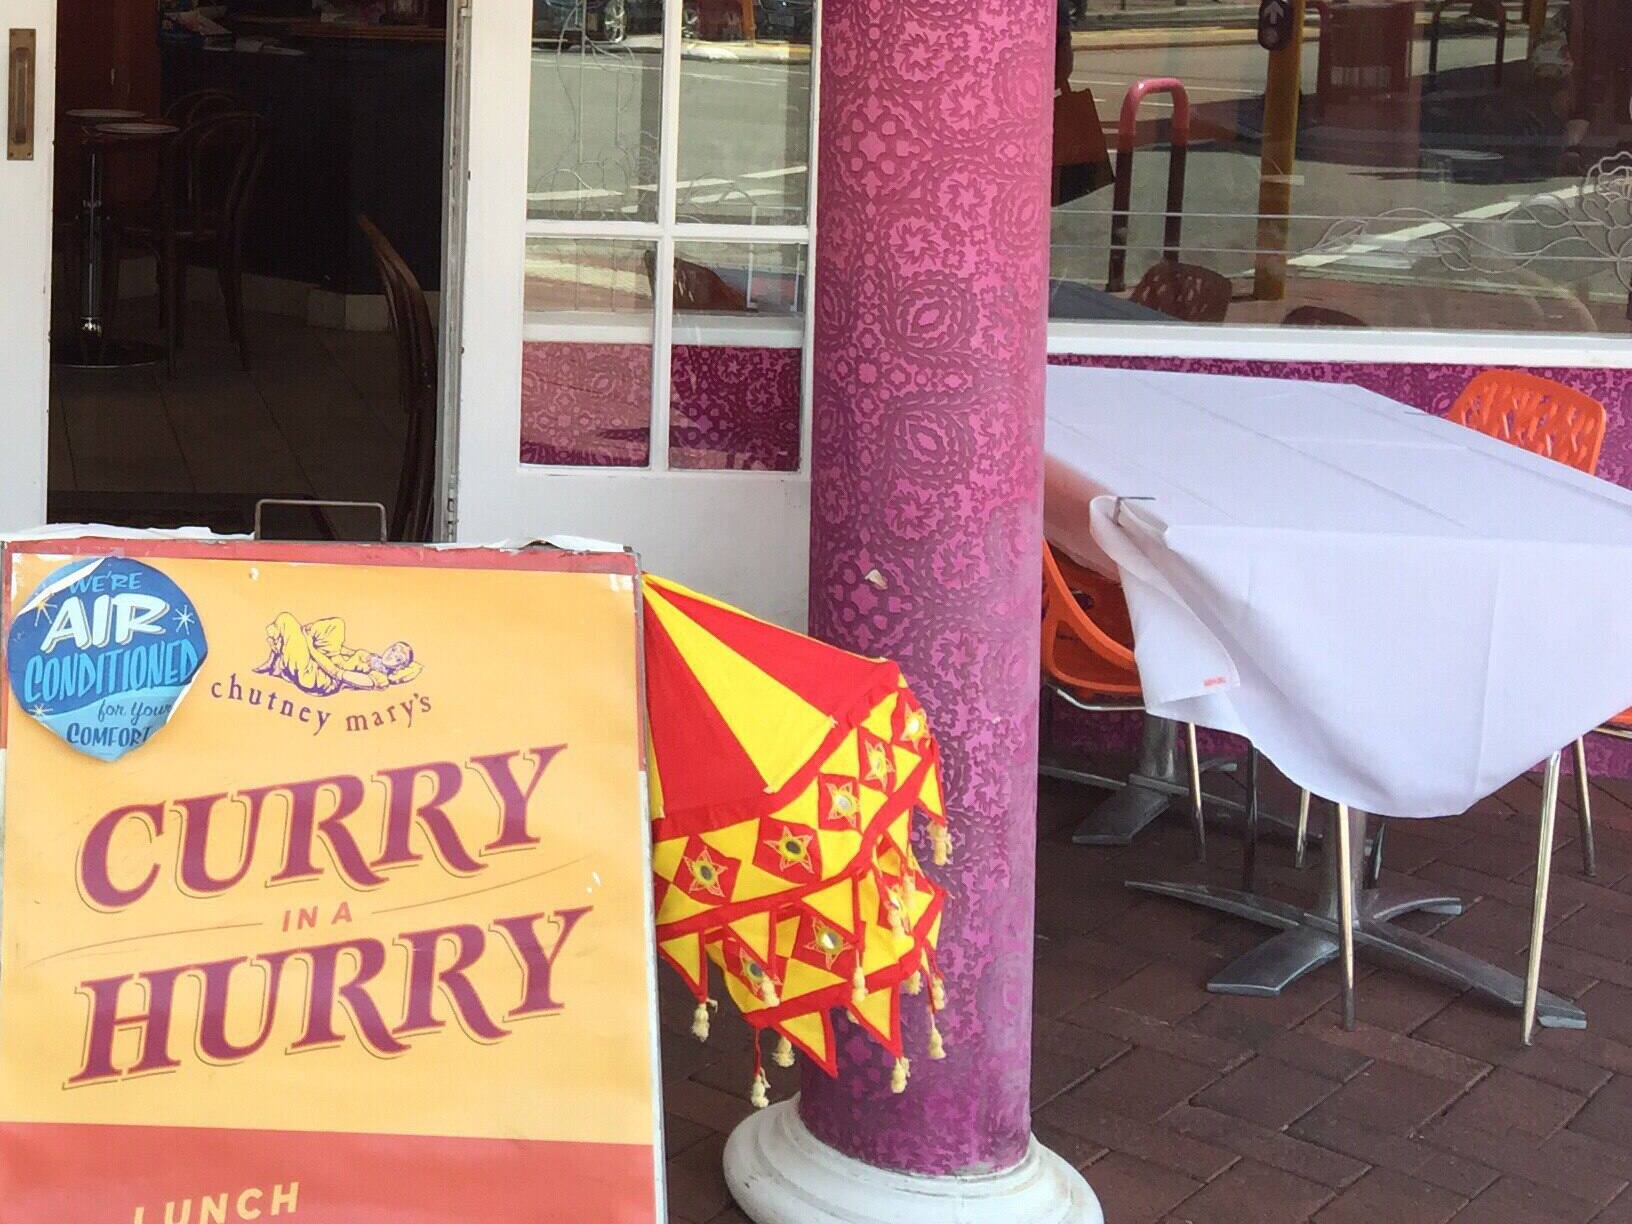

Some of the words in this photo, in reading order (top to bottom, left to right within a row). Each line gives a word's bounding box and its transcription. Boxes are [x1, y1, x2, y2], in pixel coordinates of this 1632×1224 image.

[70, 571, 142, 593] WE'RE
[40, 592, 171, 653] AIR
[24, 638, 198, 702] CONDITIONED
[97, 698, 124, 722] for
[210, 674, 332, 736] chutney
[344, 692, 433, 733] mary's
[66, 722, 153, 747] COMFORT
[76, 743, 568, 913] CURRY
[281, 906, 319, 933] IN
[331, 901, 353, 925] A
[64, 905, 594, 1088] HURRY
[132, 1180, 300, 1224] LUNCH
